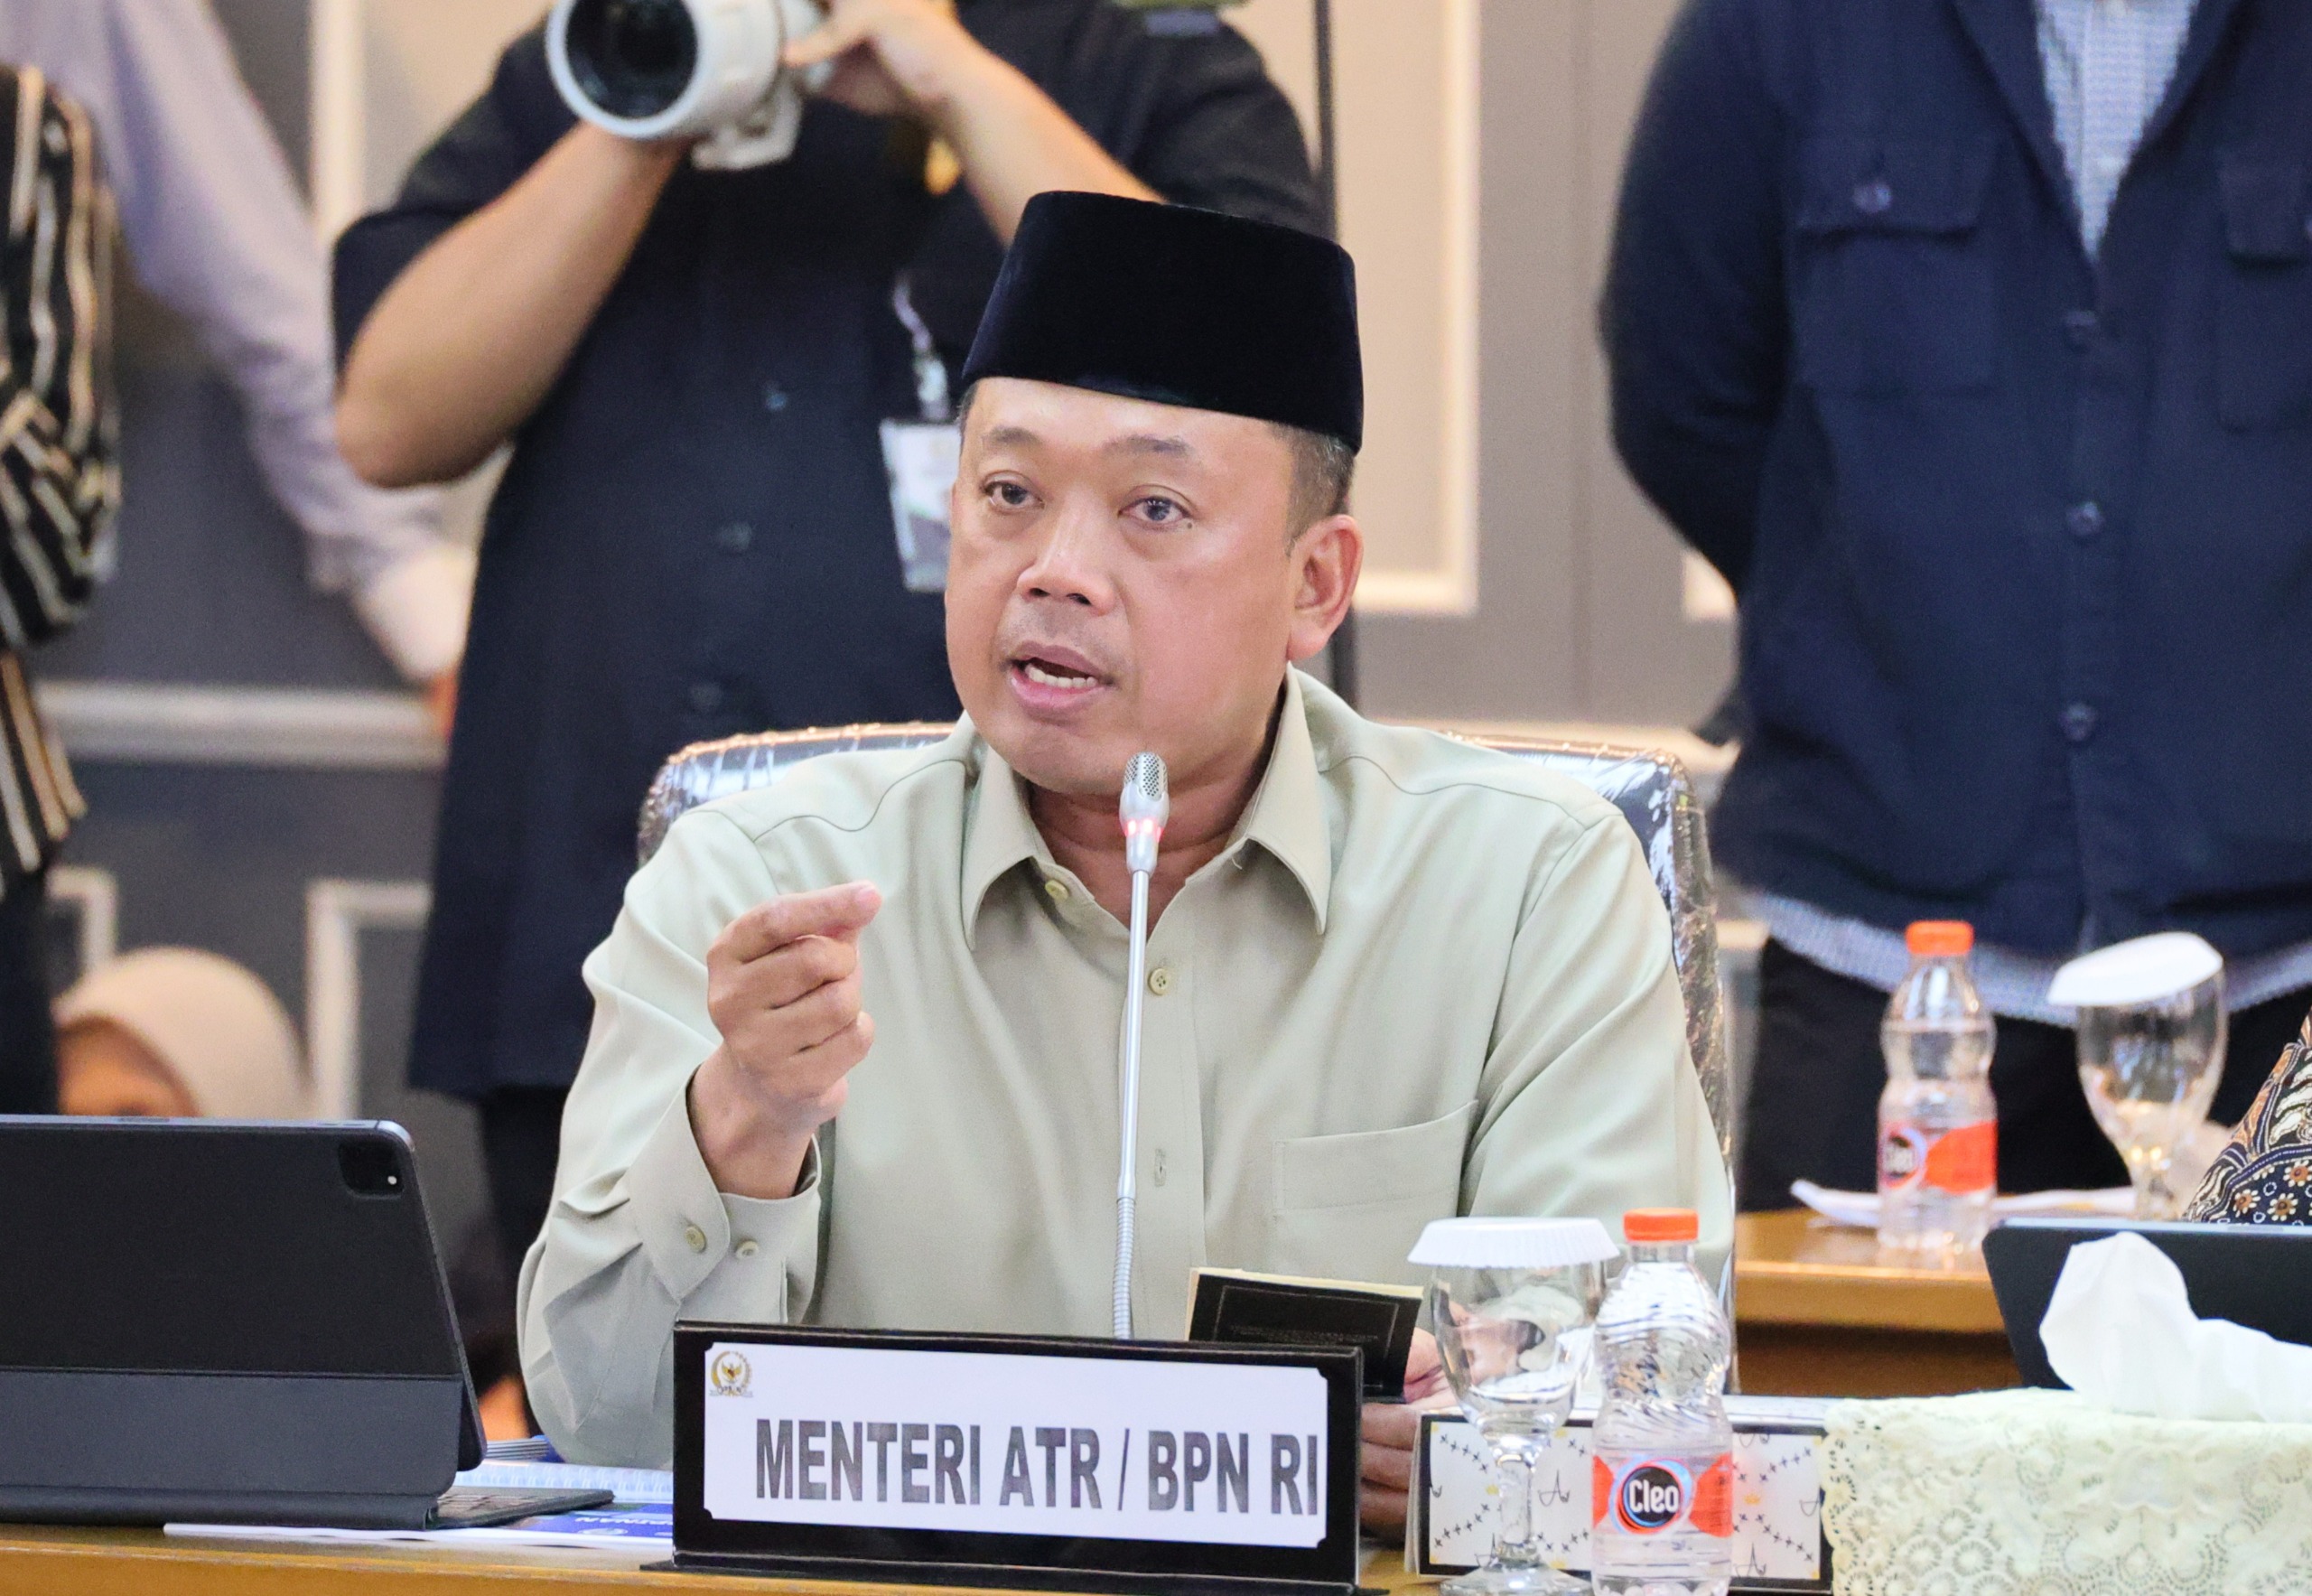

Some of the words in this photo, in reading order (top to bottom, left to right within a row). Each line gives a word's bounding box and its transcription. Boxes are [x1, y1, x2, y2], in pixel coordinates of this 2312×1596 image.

[756, 1418, 981, 1506] MENTERI
[1000, 1426, 1102, 1509] ATR
[1148, 1430, 1249, 1513] BPN
[1271, 1434, 1318, 1516] RI
[1628, 1479, 1680, 1514] Cleo
